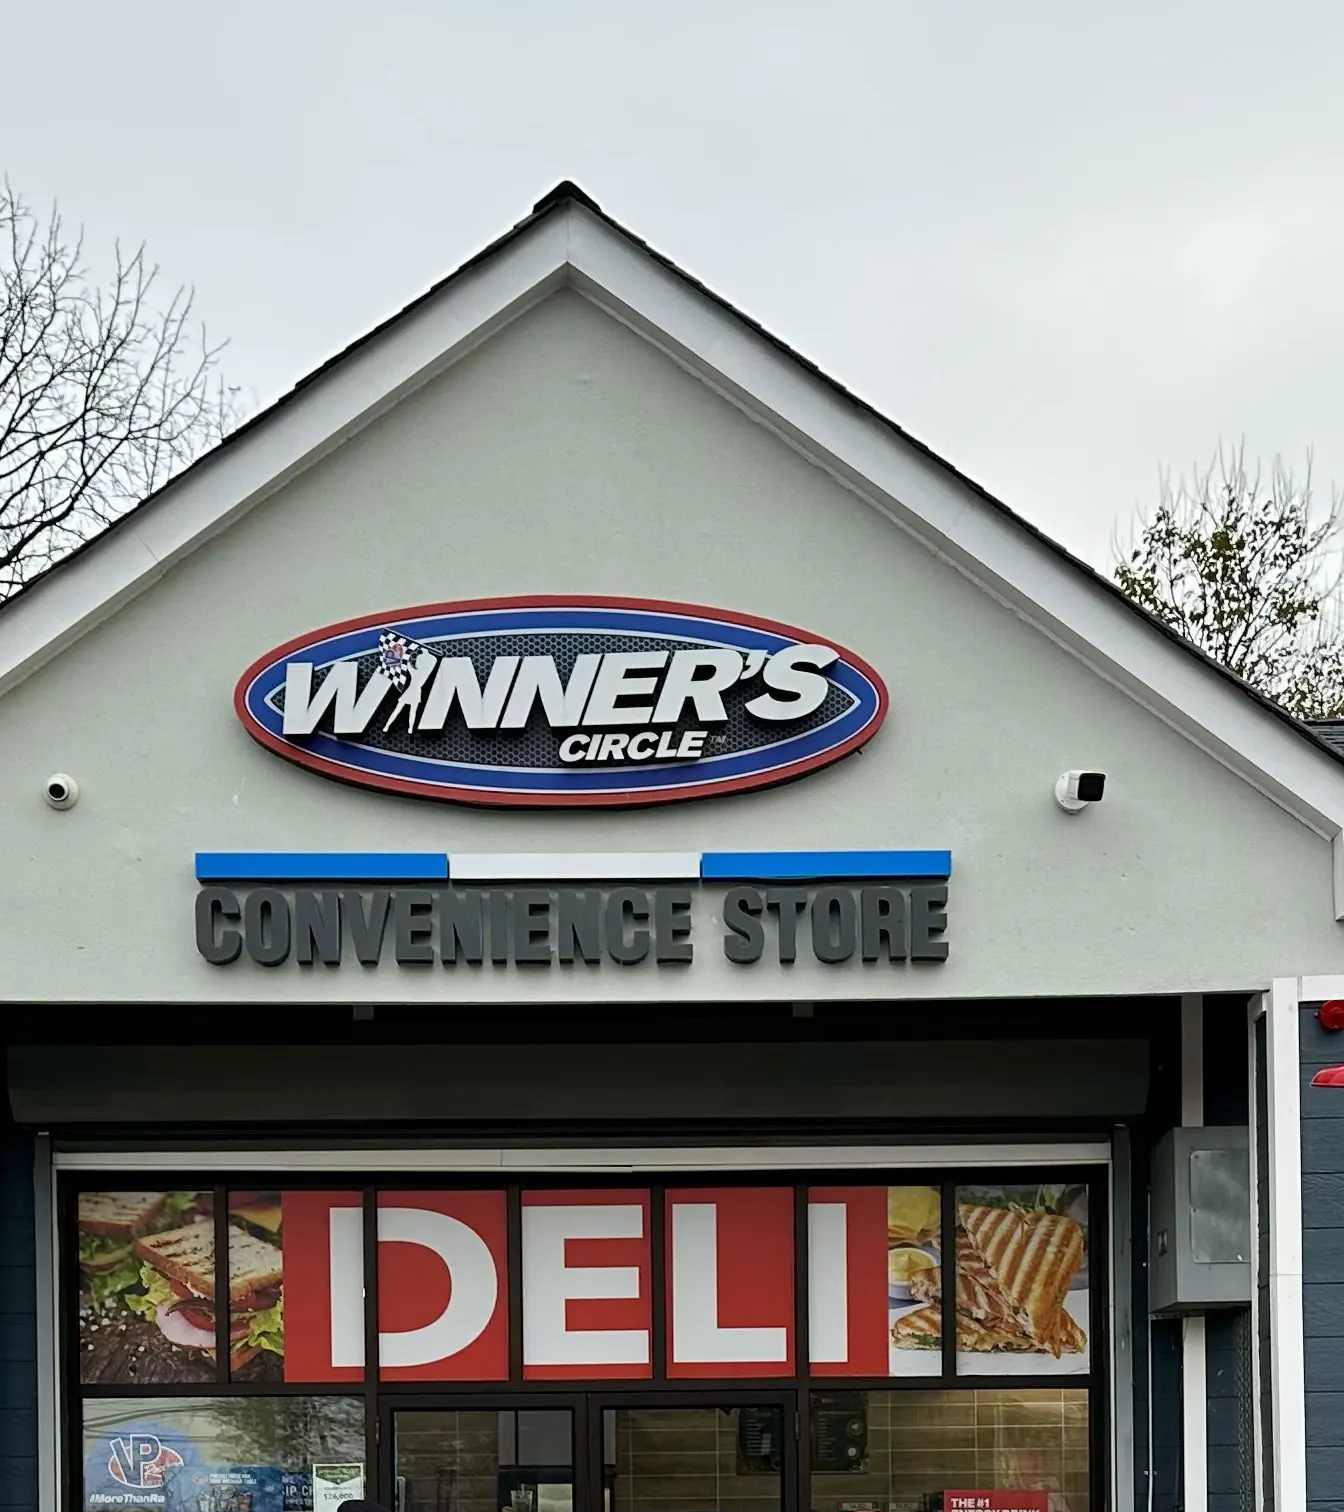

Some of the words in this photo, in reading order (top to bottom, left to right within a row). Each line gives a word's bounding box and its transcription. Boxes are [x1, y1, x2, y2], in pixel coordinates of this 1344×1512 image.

[282, 644, 841, 735] WINNER'S
[559, 731, 707, 762] CIRCLE
[195, 886, 694, 966] CONVENIENCE
[723, 885, 950, 964] STORE
[329, 1203, 848, 1368] DELI
[951, 1498, 975, 1508] THE
[976, 1498, 990, 1508] #1
